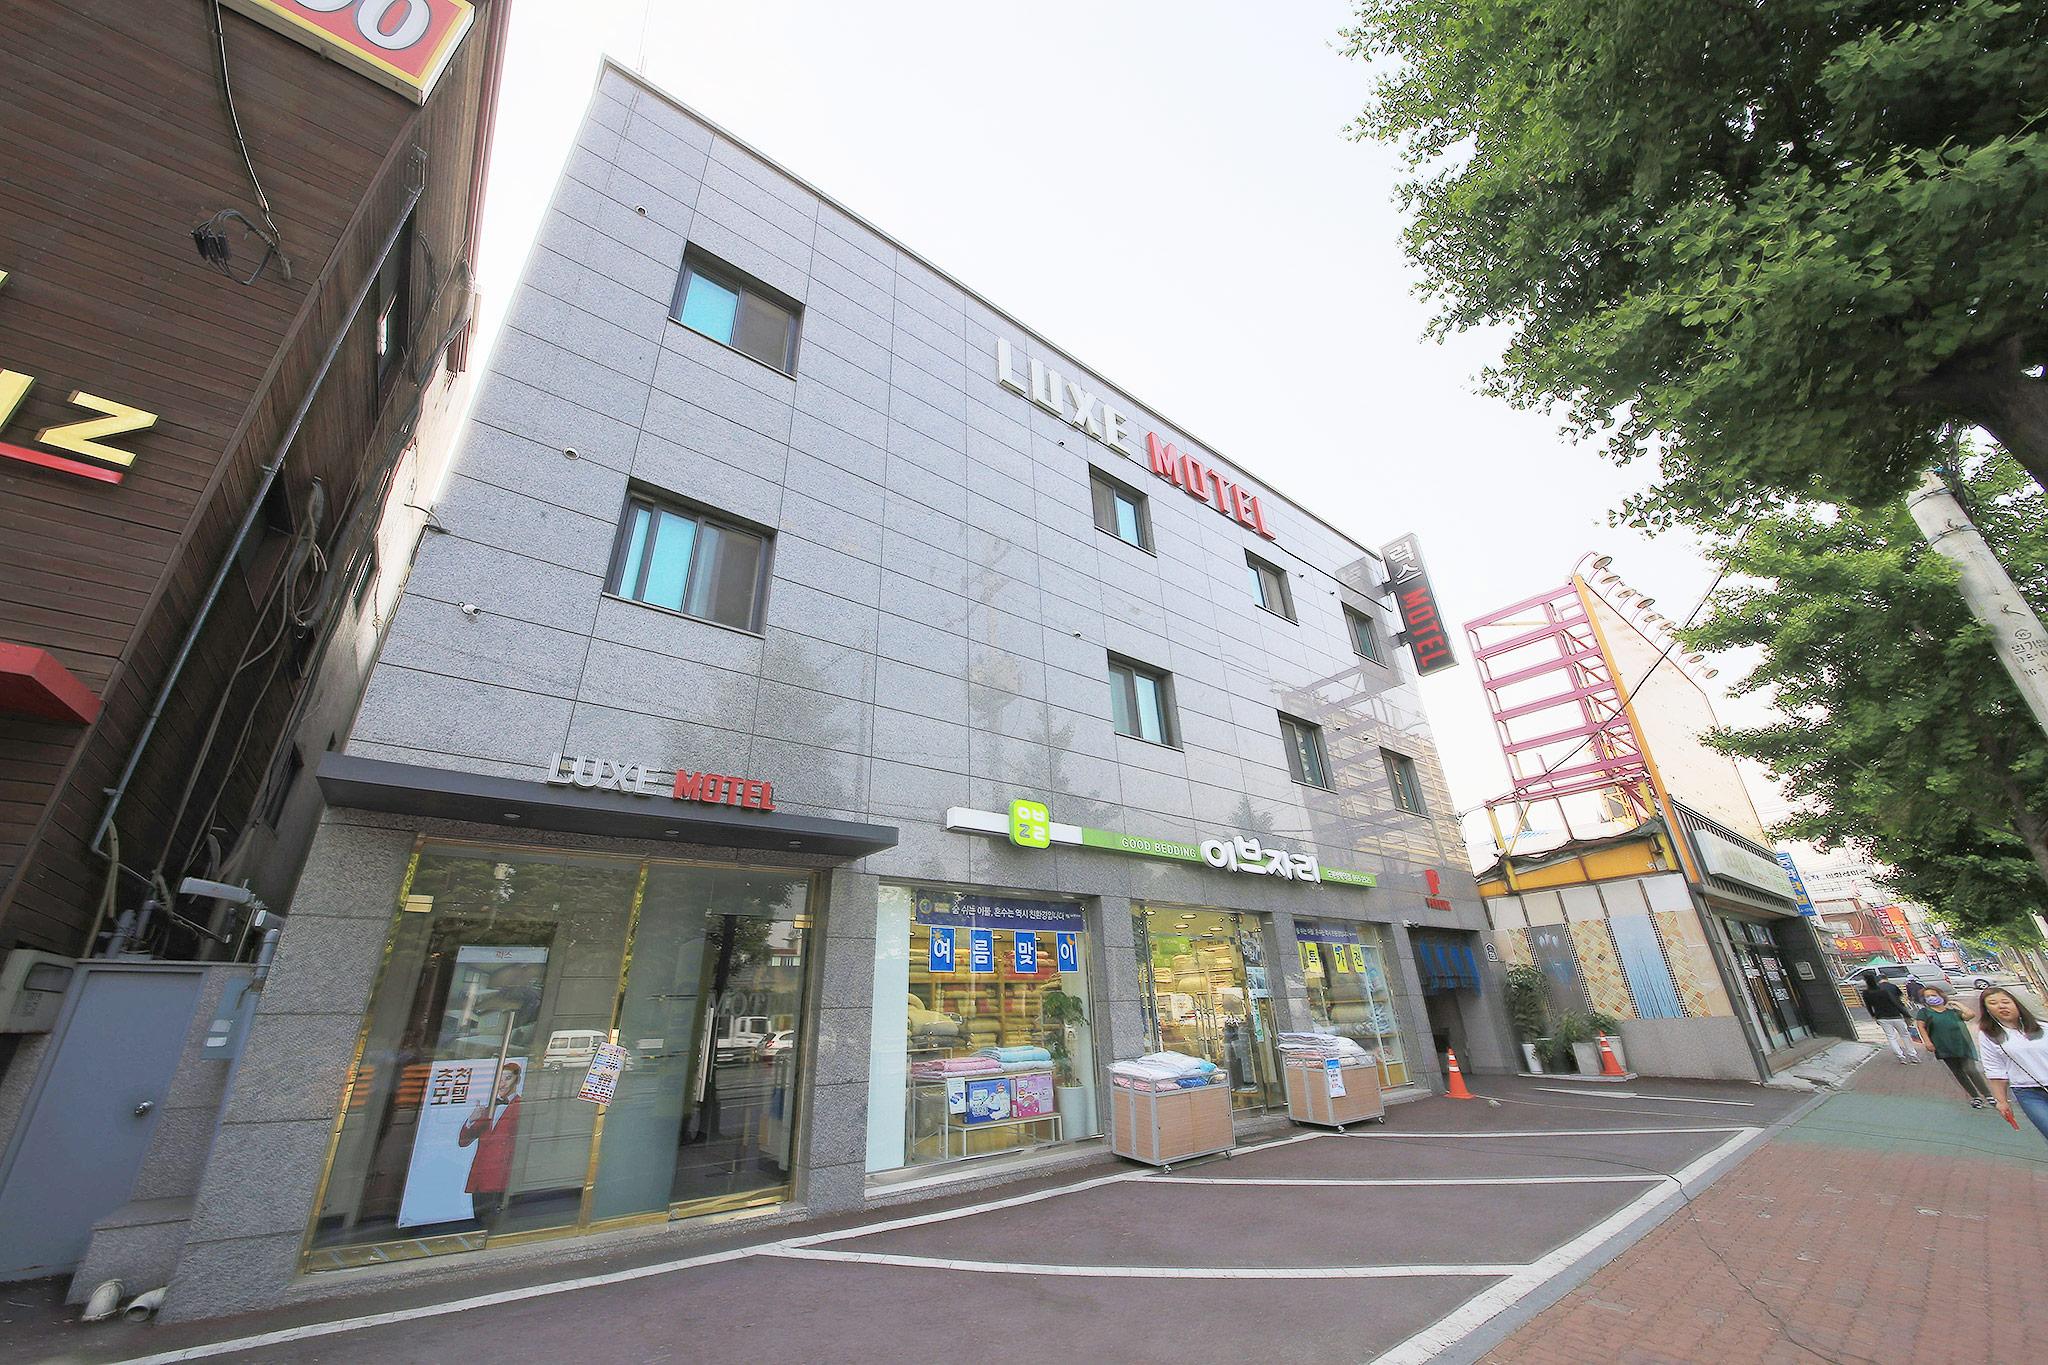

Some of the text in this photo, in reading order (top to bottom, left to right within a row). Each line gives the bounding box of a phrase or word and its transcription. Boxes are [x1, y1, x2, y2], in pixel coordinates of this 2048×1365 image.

[997, 336, 1277, 541] LUXE MOTEL
[1388, 540, 1423, 585] 럭스
[1402, 587, 1450, 668] MOTEL
[547, 751, 777, 812] LUXE MOTEL
[1121, 837, 1197, 858] GOOD BEDDING
[1200, 835, 1322, 884] 이브자리
[430, 1086, 469, 1106] 모텔
[435, 1067, 473, 1086] 추천
